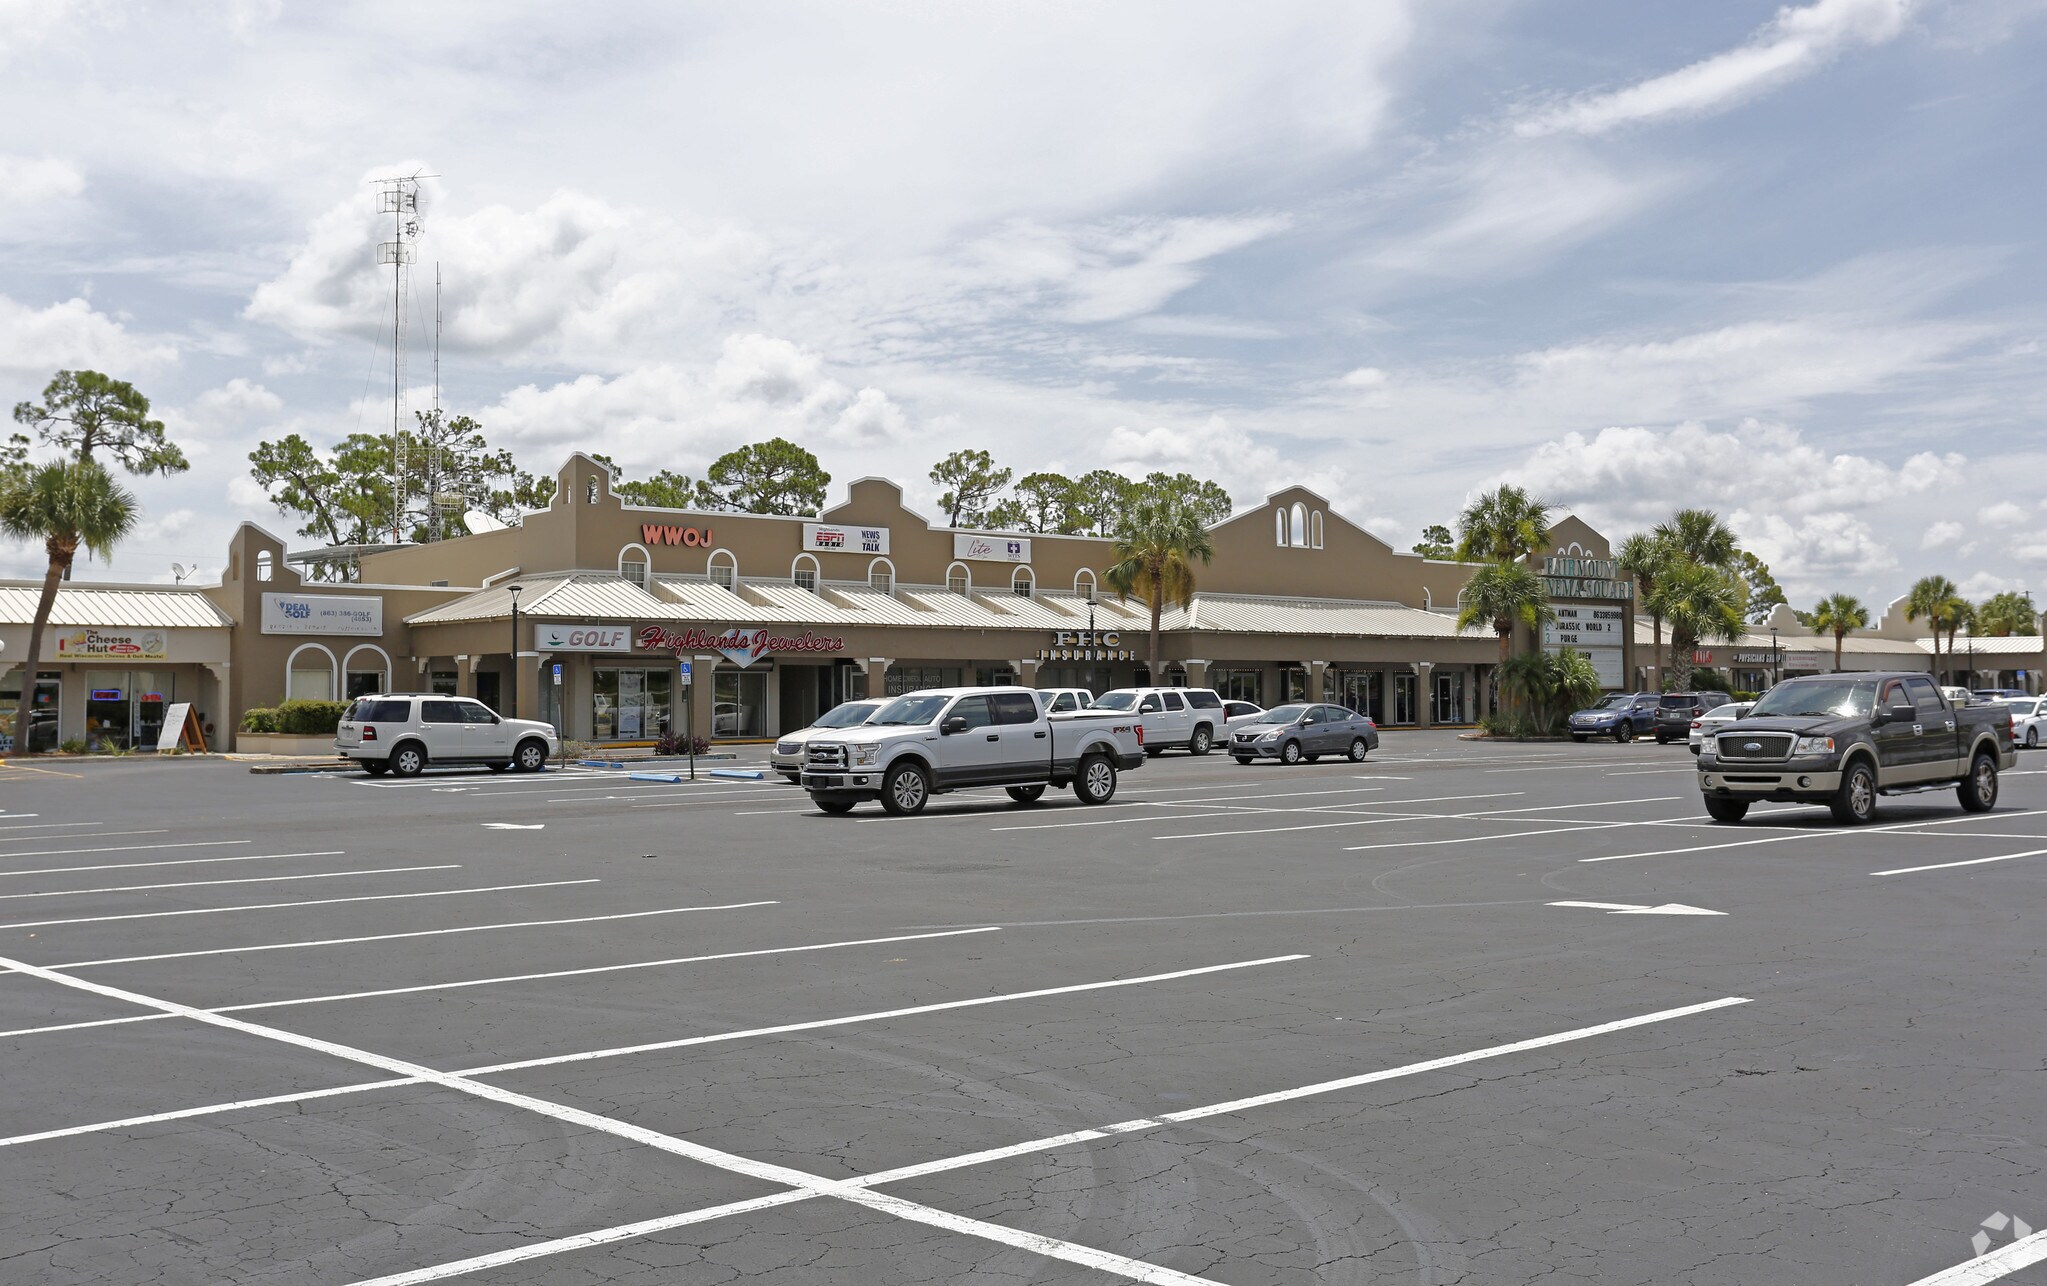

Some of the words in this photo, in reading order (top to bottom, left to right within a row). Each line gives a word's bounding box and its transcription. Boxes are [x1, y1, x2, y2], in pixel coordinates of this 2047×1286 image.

[642, 524, 713, 548] WWOJ
[816, 532, 845, 542] ESPN
[861, 531, 880, 540] NEWS
[862, 543, 879, 552] TALK
[967, 539, 992, 557] Lite
[1546, 557, 1619, 578] FAIRMOUNT
[1586, 580, 1633, 599] SQUARE
[1558, 609, 1577, 618] ANTMAN
[1556, 623, 1581, 632] JURASSIC
[1586, 623, 1602, 632] WORLD
[1607, 624, 1611, 632] 2
[87, 635, 132, 644] Cheese
[568, 630, 624, 647] GOLF
[639, 626, 751, 657] Highlands
[751, 629, 845, 657] Jewelers
[1055, 631, 1120, 647] FHC
[1561, 634, 1578, 643] PURGE
[87, 644, 109, 653] Hut
[1040, 649, 1135, 661] INSURANCE
[924, 675, 941, 683] AUTO
[1113, 726, 1131, 734] FX4
